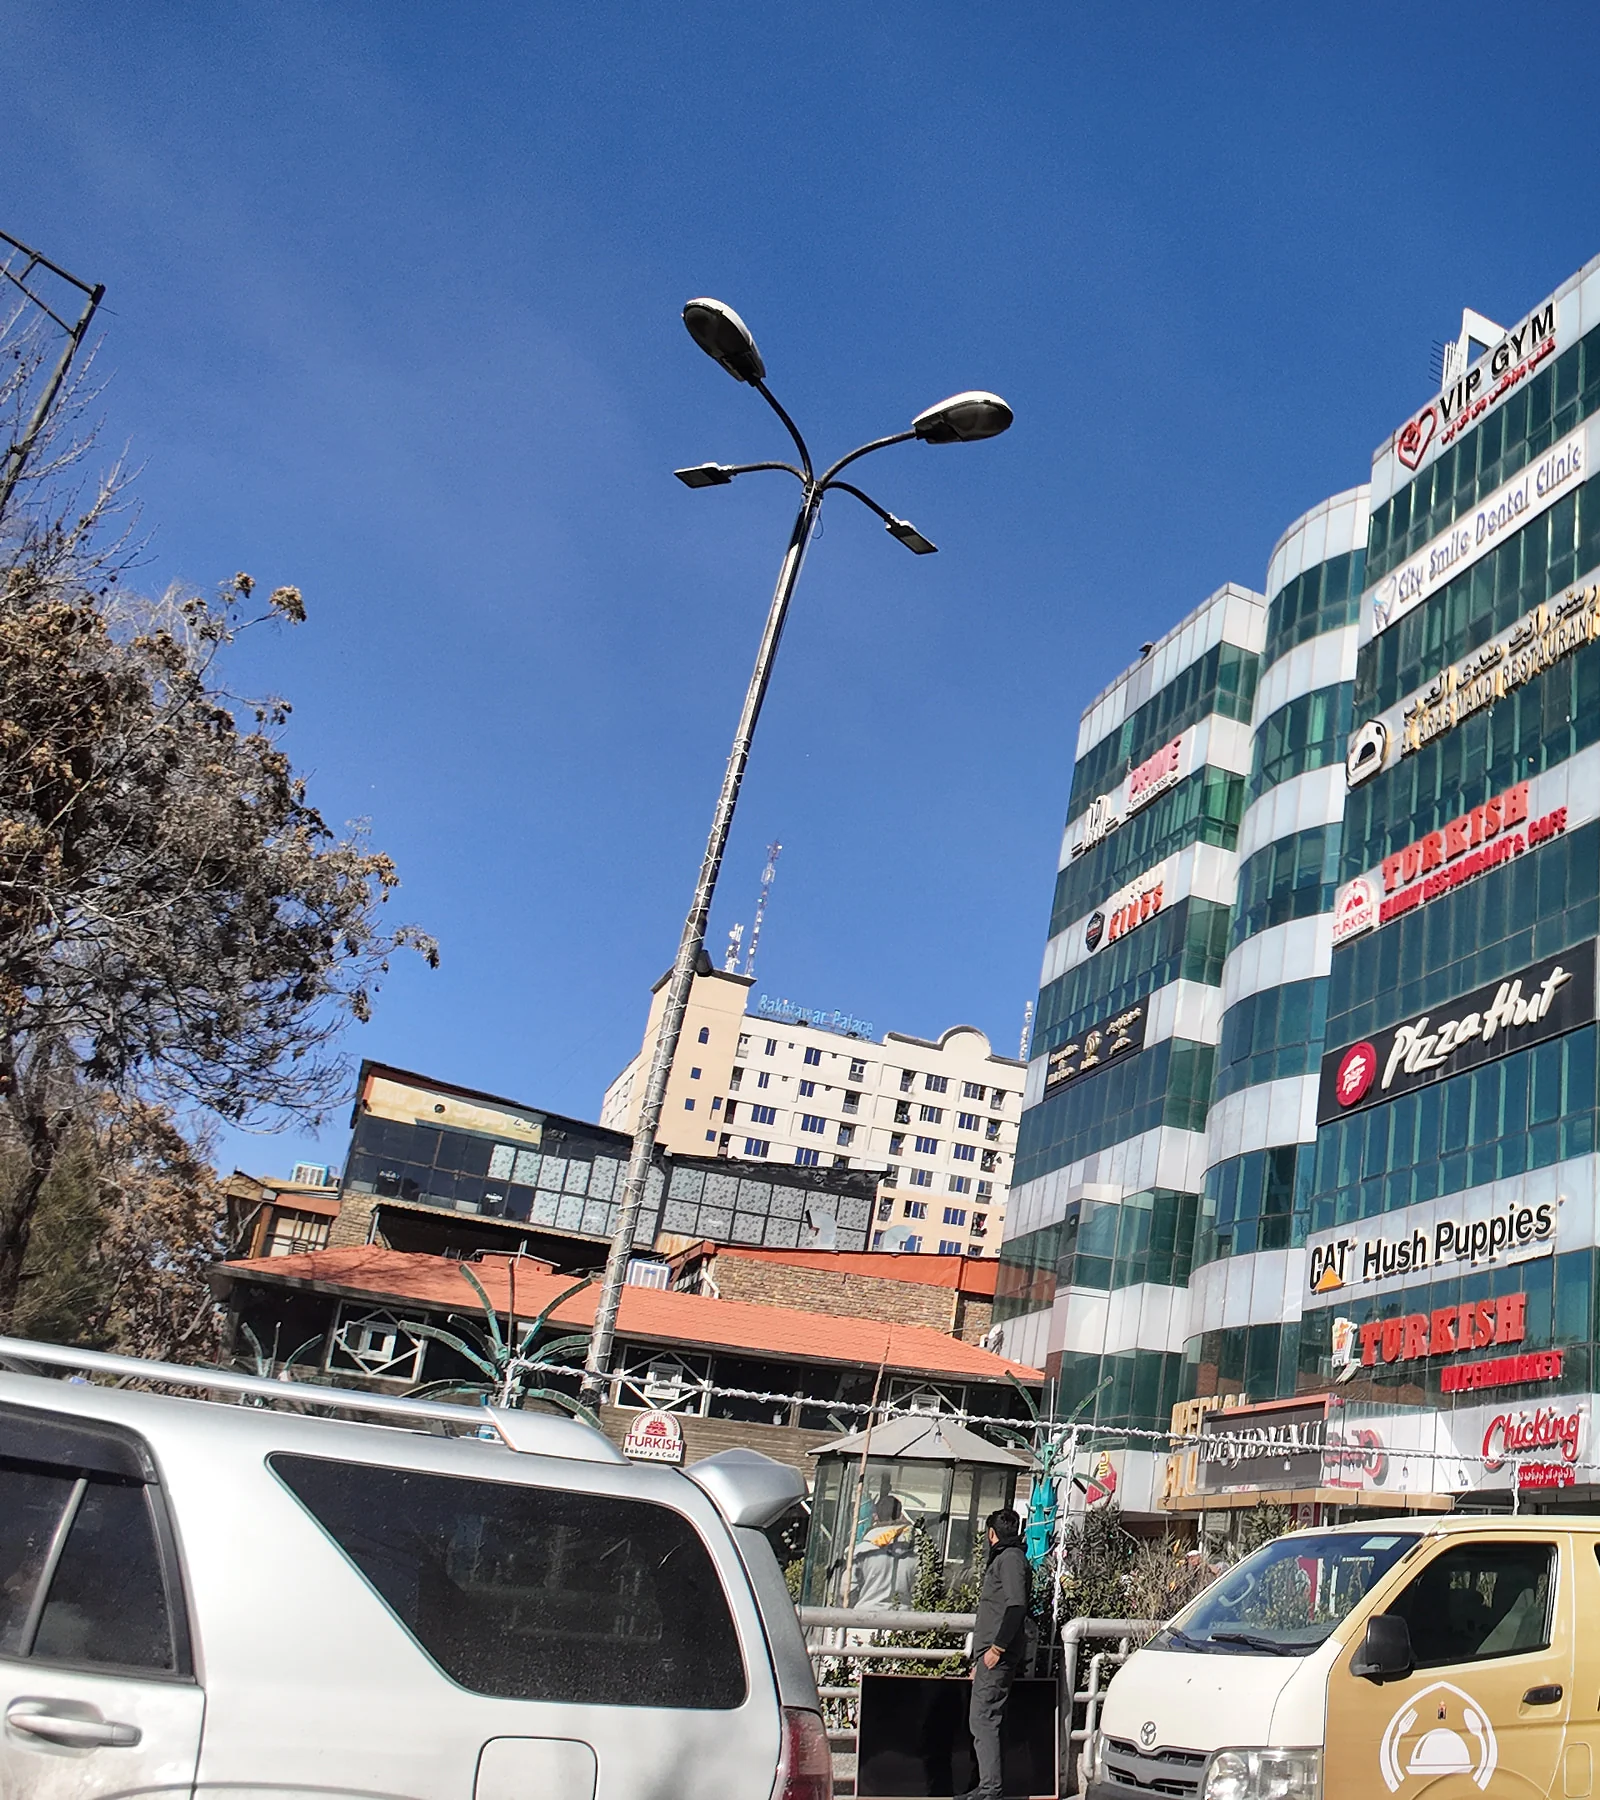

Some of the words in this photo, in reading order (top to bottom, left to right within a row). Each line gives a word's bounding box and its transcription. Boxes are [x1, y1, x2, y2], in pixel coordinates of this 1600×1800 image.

[1491, 303, 1555, 376] GYM
[1398, 566, 1424, 603] City
[1429, 531, 1471, 580] Smile
[1475, 477, 1530, 546] Dental
[1536, 442, 1582, 498] Clinic
[1381, 780, 1530, 893] TURKISH
[759, 994, 828, 1024] Bakhtawar
[832, 1009, 873, 1036] Palace
[1381, 1016, 1483, 1090] Pizza
[1481, 965, 1574, 1042] Hut
[1310, 1238, 1349, 1292] CAT
[1362, 1227, 1427, 1278] Hush
[1434, 1202, 1552, 1263] Puppies
[1360, 1292, 1528, 1367] TURKISH
[626, 1434, 682, 1452] TURKISH
[1482, 1406, 1581, 1469] Chicking
